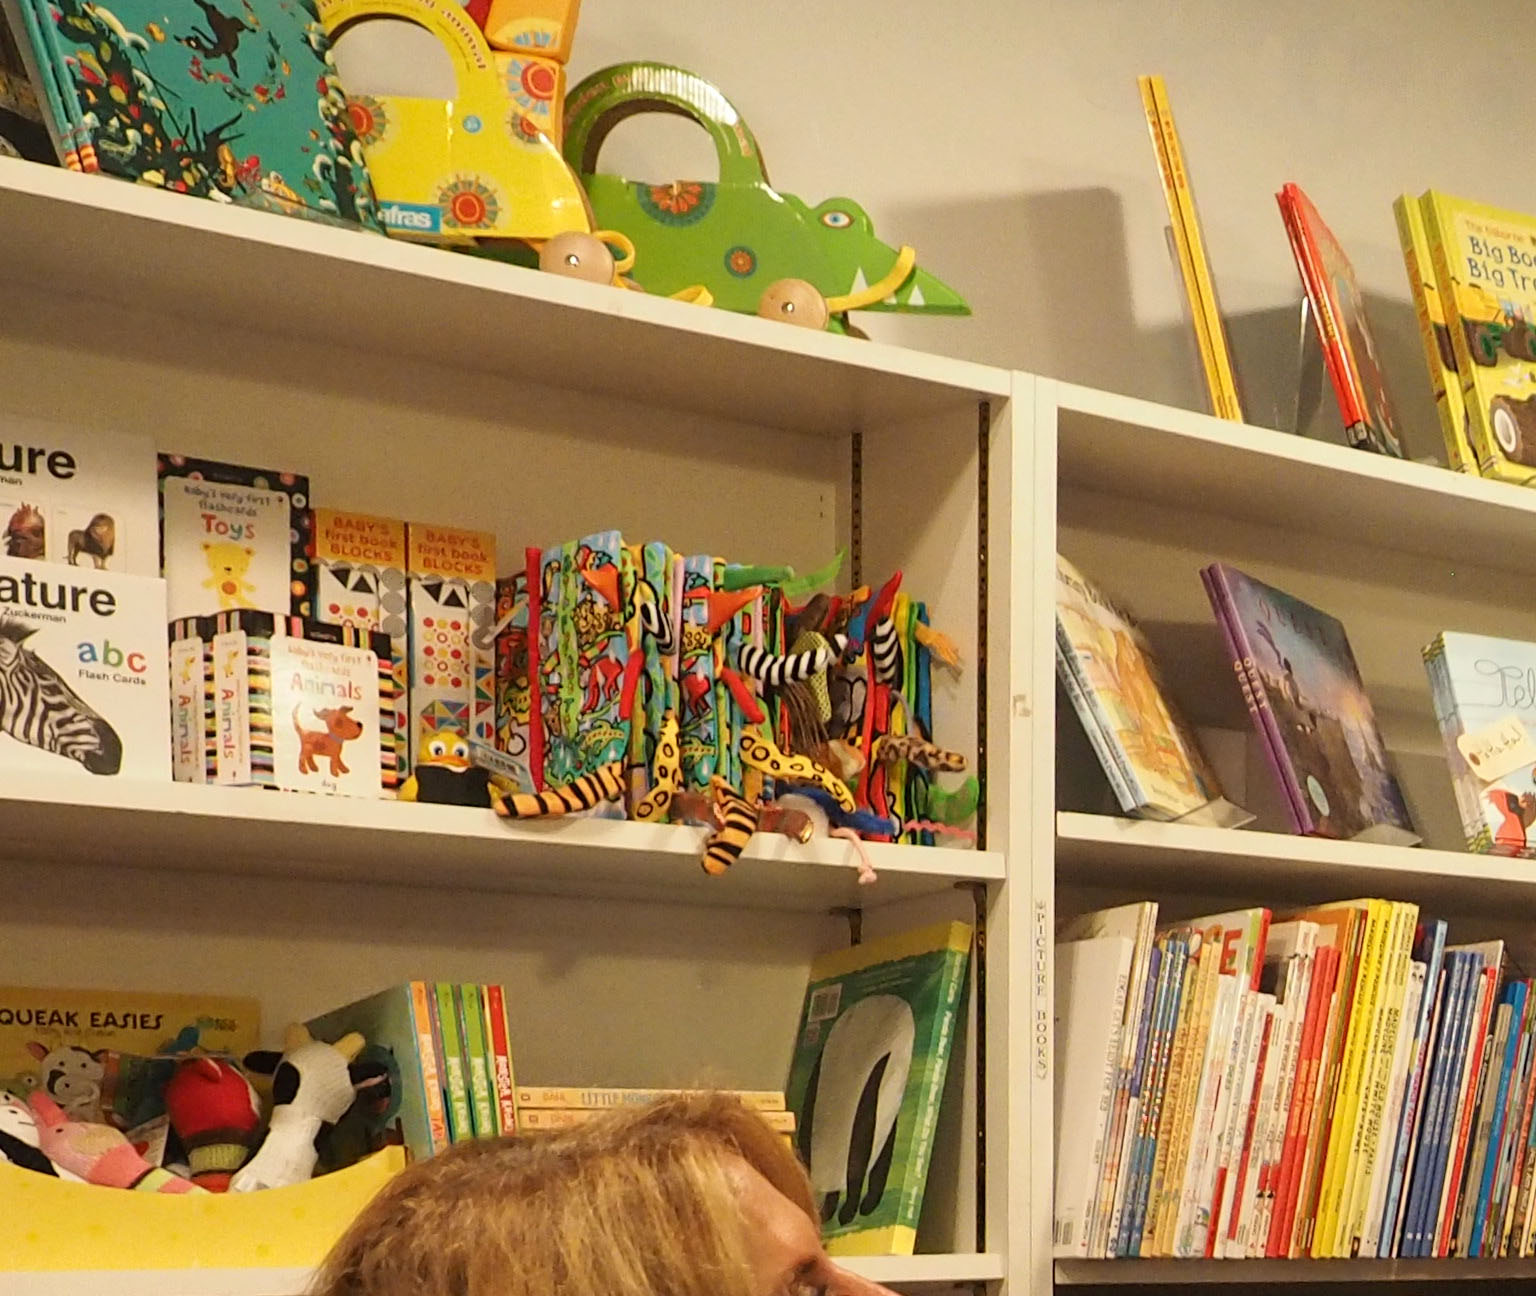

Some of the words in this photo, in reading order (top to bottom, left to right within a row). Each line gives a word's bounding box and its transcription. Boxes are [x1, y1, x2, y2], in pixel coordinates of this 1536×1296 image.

[1469, 235, 1504, 262] Big
[1467, 256, 1505, 289] Big
[201, 513, 256, 540] Toys
[325, 529, 355, 544] first
[360, 535, 400, 548] book
[333, 517, 389, 534] BABY'S
[417, 543, 444, 559] first
[448, 548, 489, 564] book
[425, 530, 481, 550] BABY'S
[3, 607, 67, 624] Zuckerman
[77, 639, 148, 674] abc
[78, 668, 111, 682] Flash
[114, 673, 147, 686] Cards
[290, 670, 363, 701] Animals
[177, 695, 192, 766] Animals
[220, 688, 235, 760] Animals
[90, 1012, 165, 1030] EASIES
[1385, 1008, 1399, 1056] MADELINE
